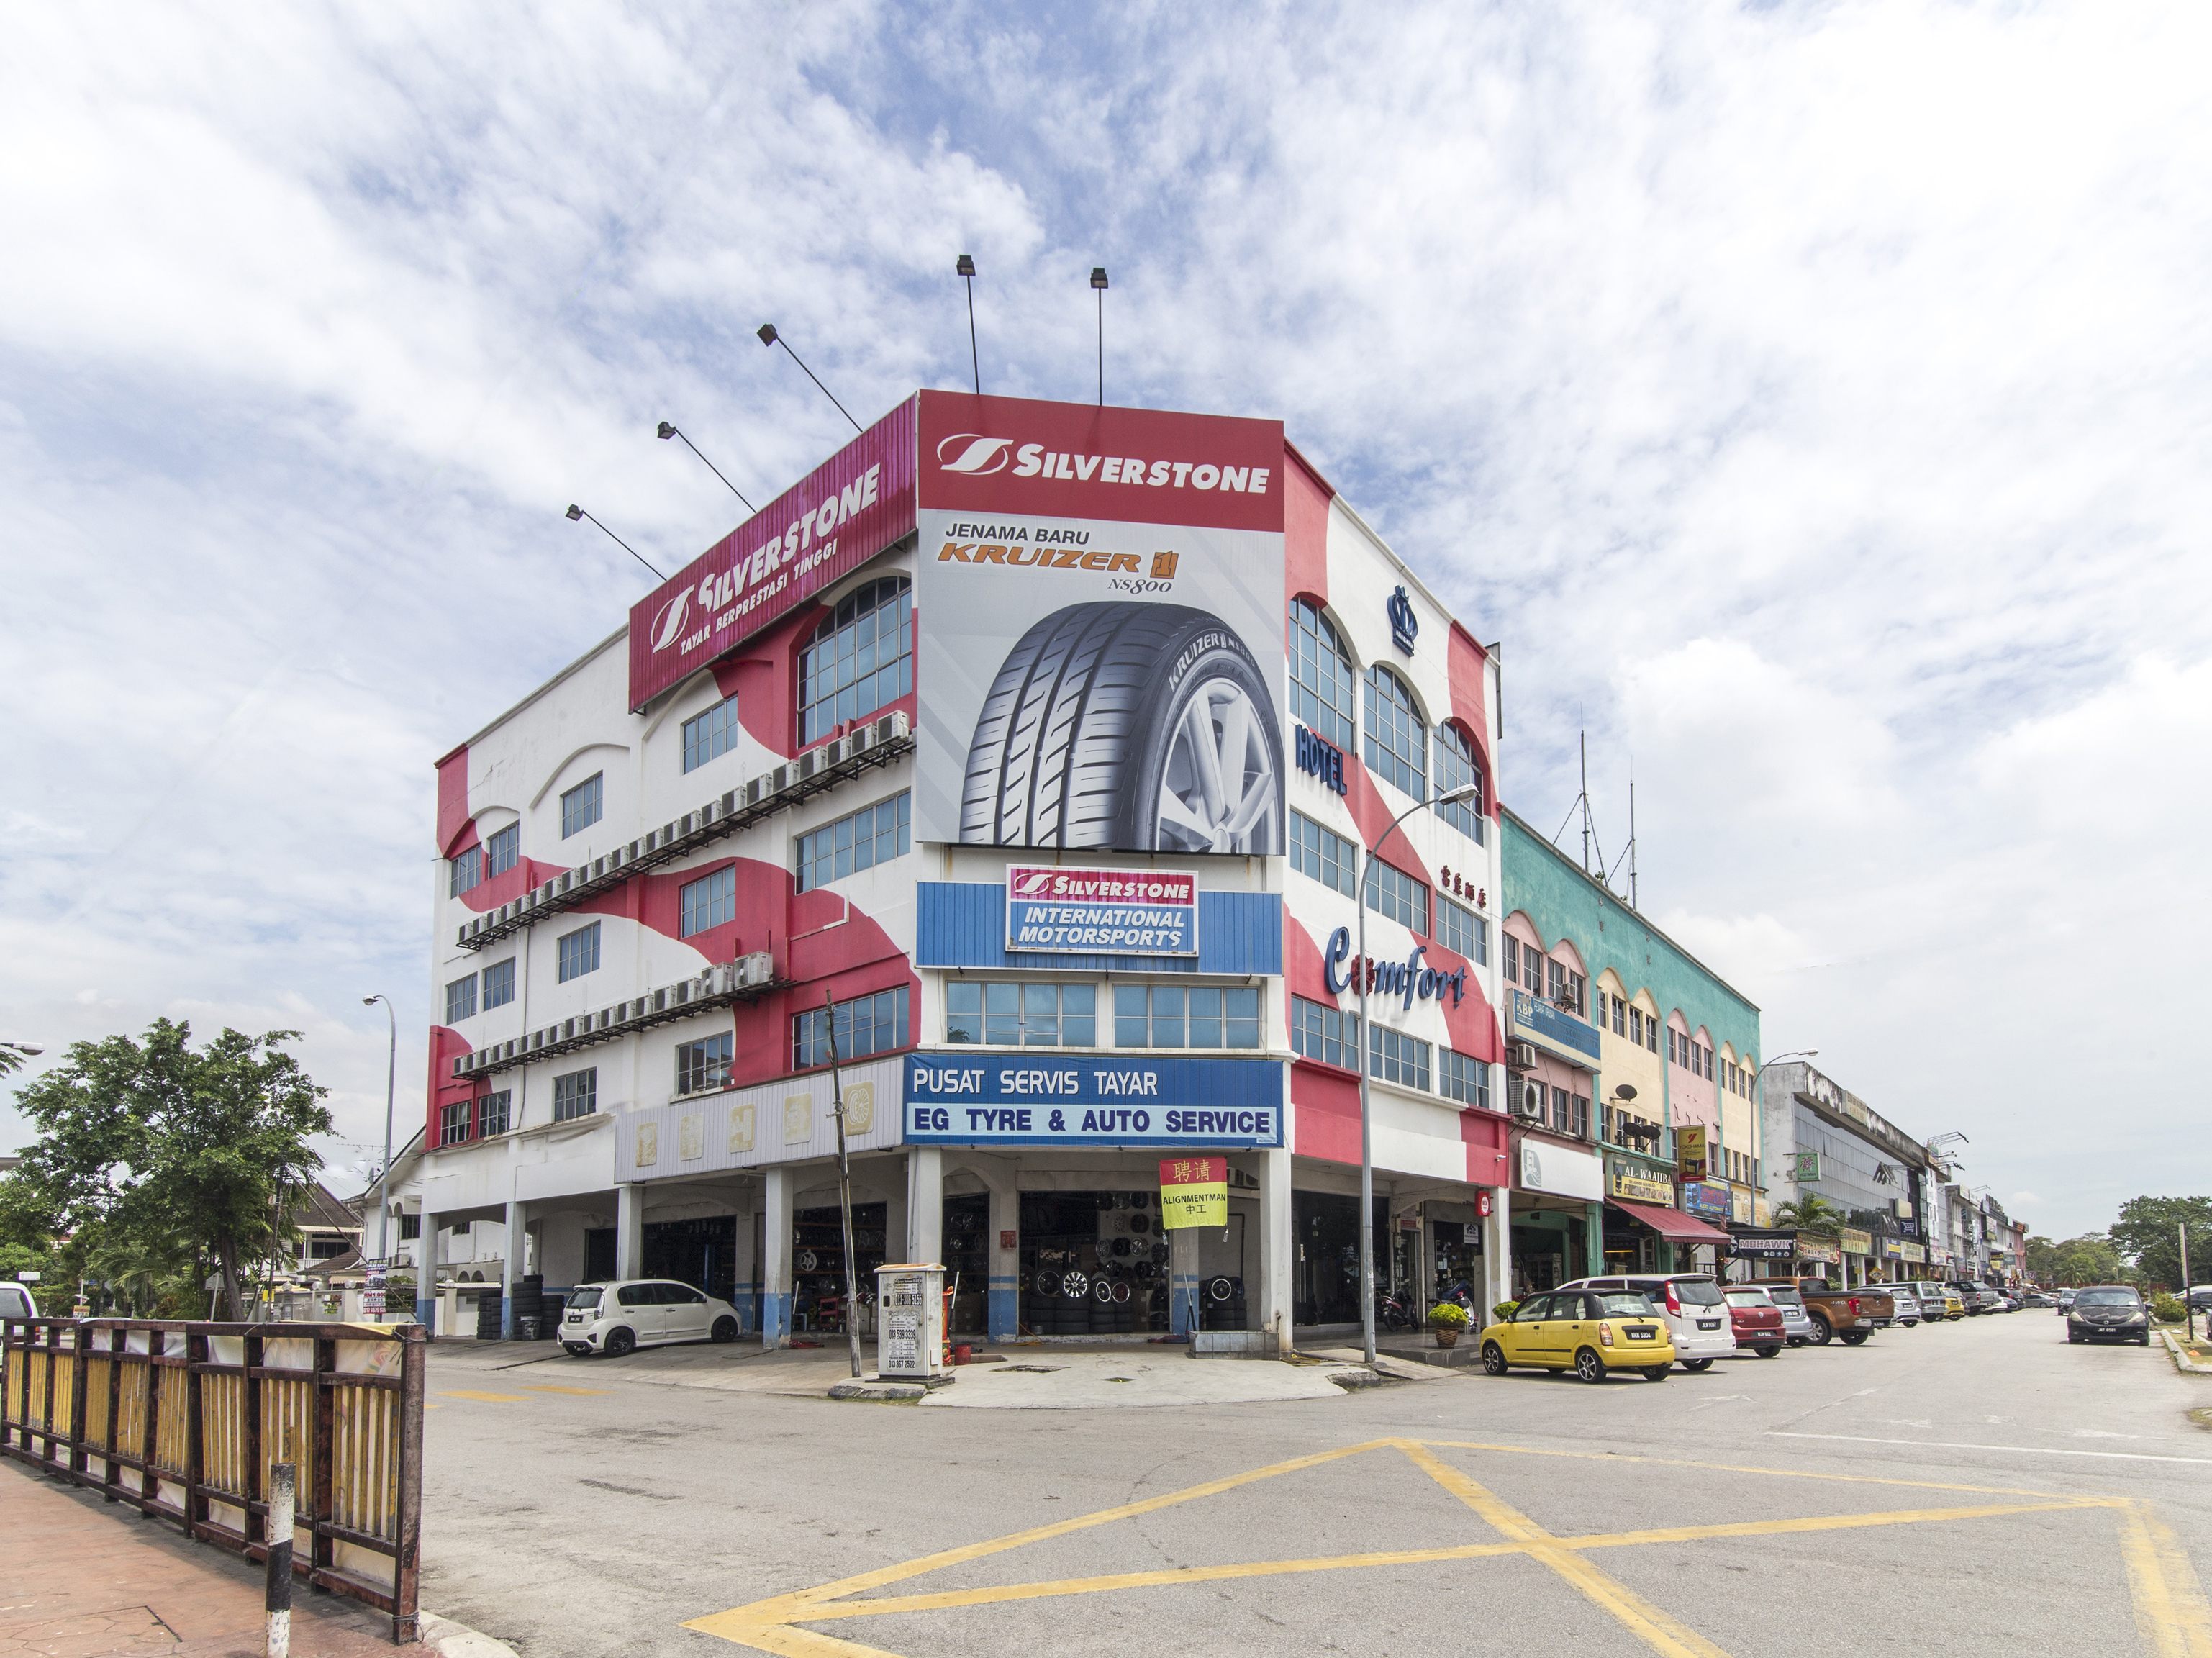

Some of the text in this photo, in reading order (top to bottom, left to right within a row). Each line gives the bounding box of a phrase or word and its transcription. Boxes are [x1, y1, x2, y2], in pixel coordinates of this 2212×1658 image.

[1011, 443, 1270, 494] SILVERSTONE
[697, 462, 880, 613] SILVERSTONE
[945, 523, 1090, 545] JENAMA BARU
[937, 543, 1142, 573] KRUIZER
[680, 538, 838, 656] TAYAR BERPRESTASI TINGGI
[1107, 578, 1173, 595] NS800
[1168, 633, 1220, 693] KRUIZER
[1295, 723, 1347, 797] HOTEL
[1051, 875, 1190, 899] SILVERSTONE
[1025, 907, 1185, 928] INTERNATIONAL
[1018, 926, 1182, 947] MOTORSPORTS
[1324, 926, 1469, 1011] Comfort
[1516, 1004, 1533, 1017] KBP
[1535, 1022, 1565, 1041] MANAGEMENT
[913, 1069, 1158, 1096] PUSAT SERVIS TAYAR
[914, 1107, 1270, 1133] EG TYRE & AUTO SERVICE
[1174, 1159, 1211, 1182] 聘请
[1163, 1193, 1226, 1205] ALIGNMENTMAN
[1186, 1204, 1207, 1215] 中工
[1739, 1239, 1791, 1249] MOHAWK
[912, 1294, 923, 1305] 5155
[905, 1329, 916, 1339] 3339
[905, 1359, 915, 1368] 2522
